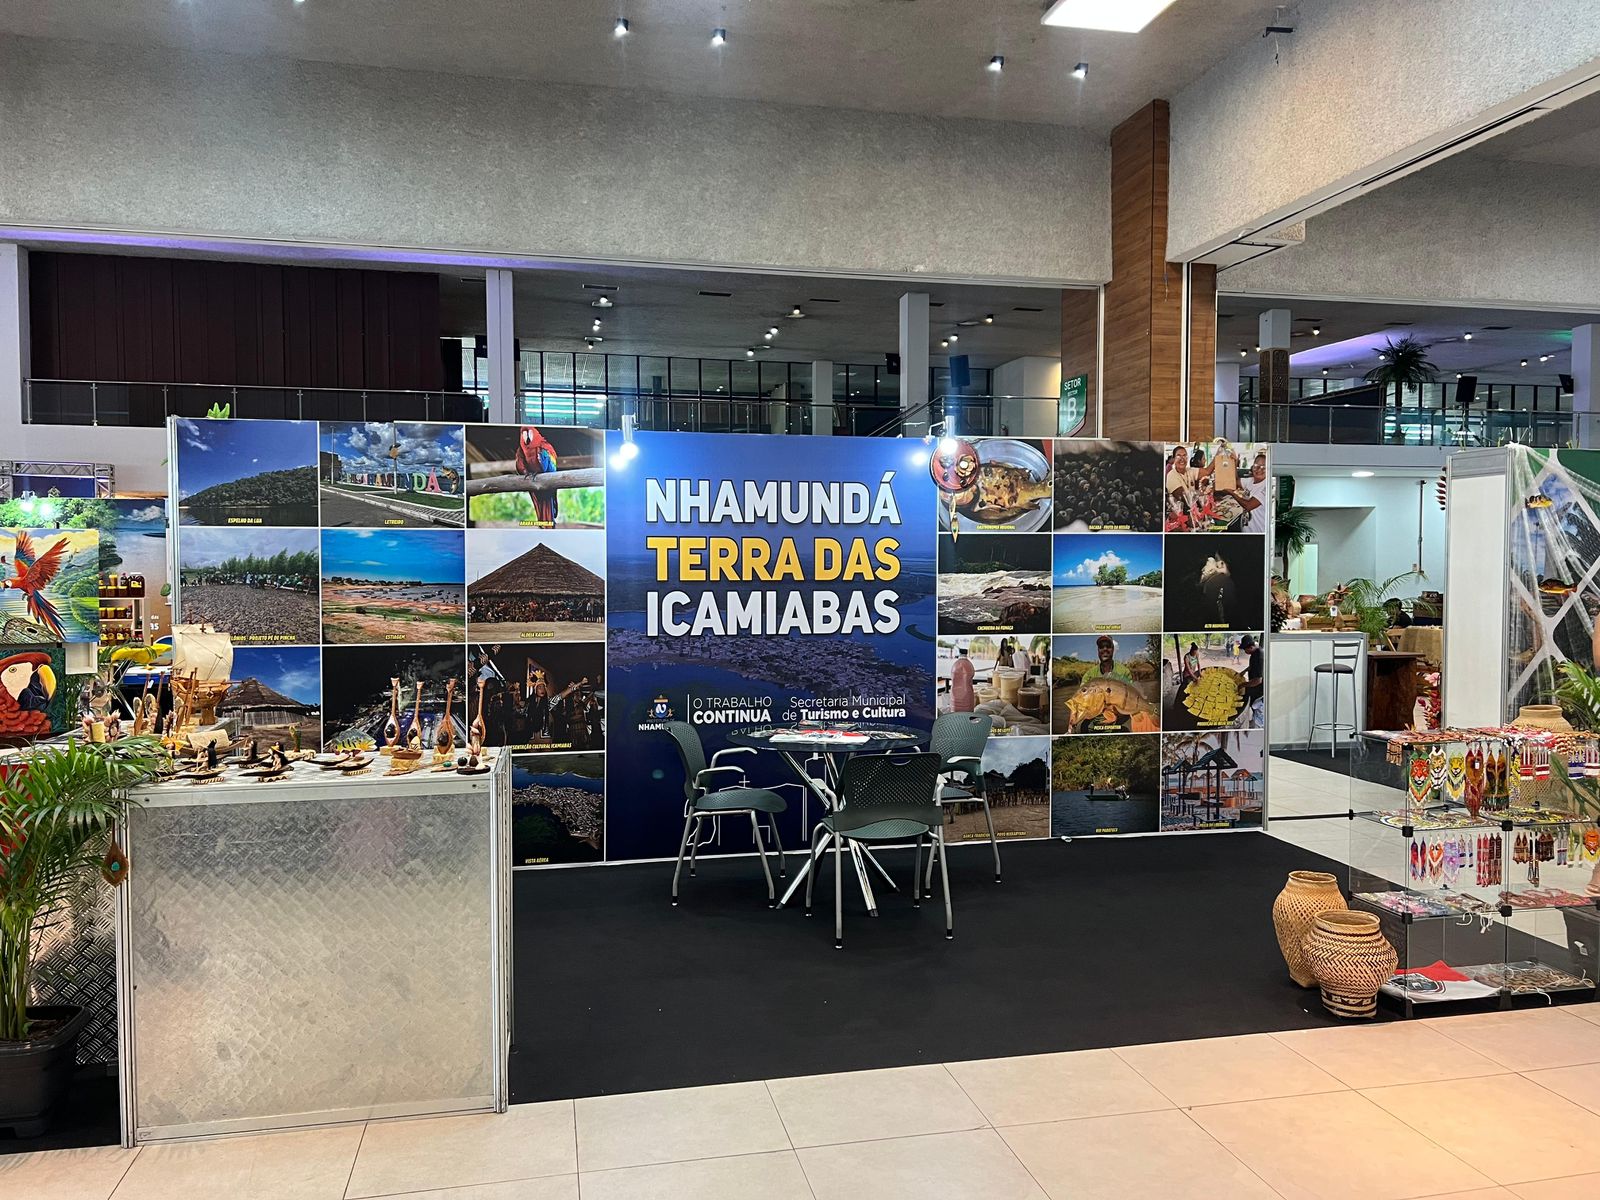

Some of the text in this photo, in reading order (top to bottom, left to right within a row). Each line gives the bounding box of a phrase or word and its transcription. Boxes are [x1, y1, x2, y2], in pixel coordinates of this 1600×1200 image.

[1064, 377, 1082, 391] SETOR
[1067, 397, 1077, 421] B
[645, 471, 902, 525] NHAMUNDÁ
[646, 536, 902, 582] TERRA DAS
[646, 589, 901, 637] ICAMIABAS
[693, 696, 772, 709] O TRABALHO
[790, 694, 906, 709] Secretaria Municipal
[693, 709, 772, 724] CONTINUA
[782, 706, 906, 721] de Turismo e Cultura
